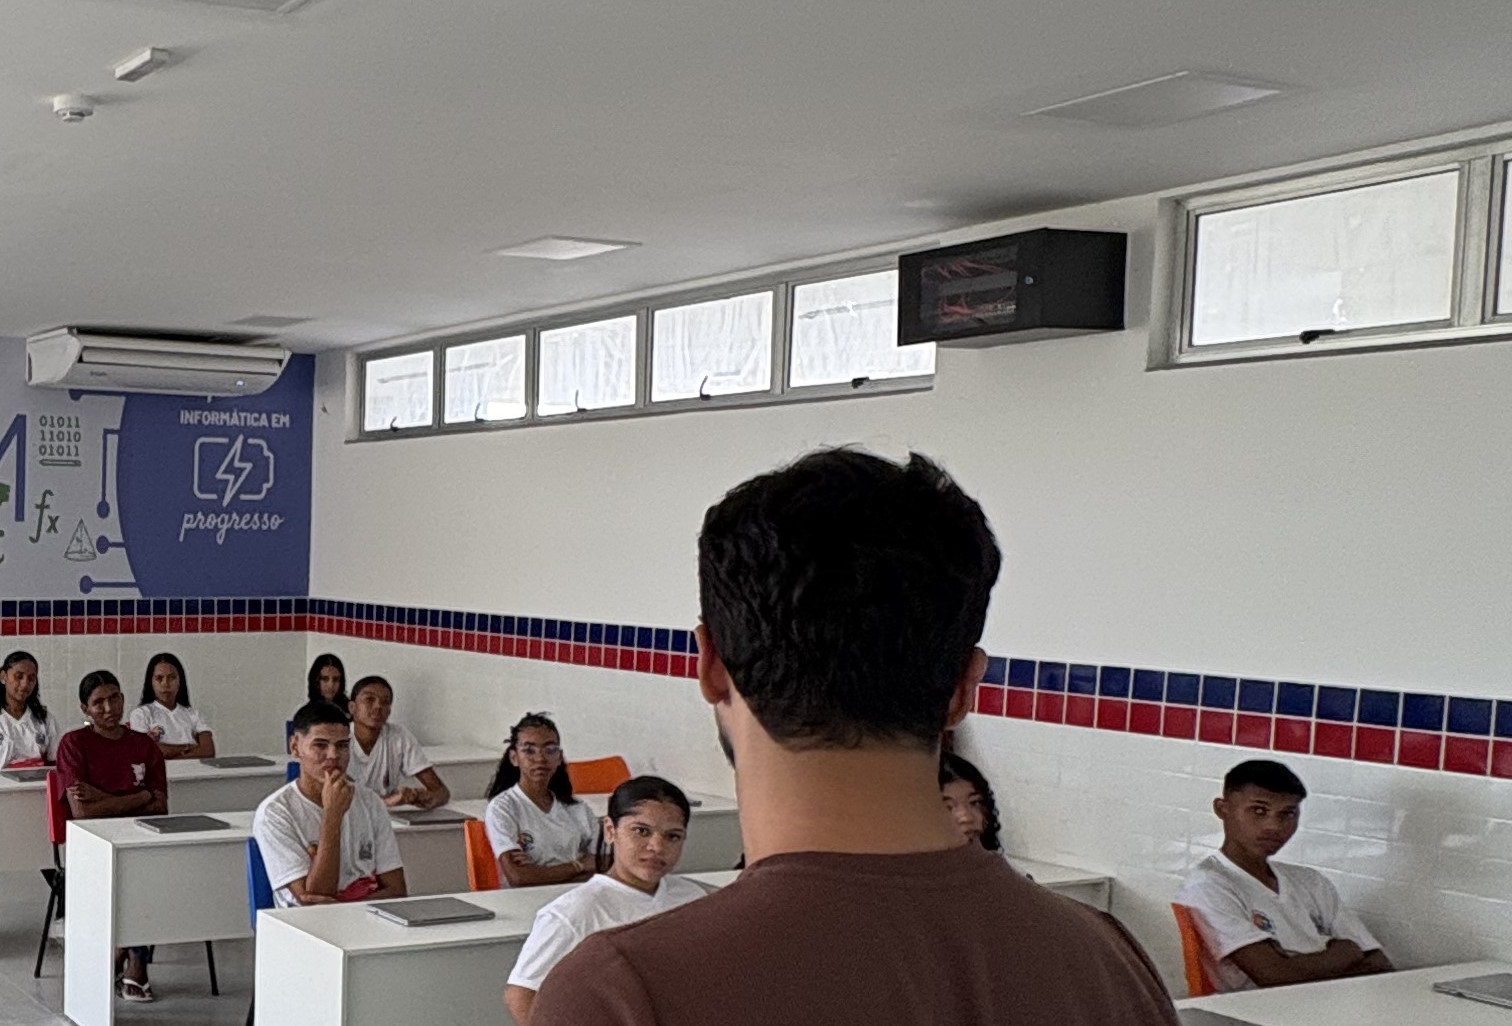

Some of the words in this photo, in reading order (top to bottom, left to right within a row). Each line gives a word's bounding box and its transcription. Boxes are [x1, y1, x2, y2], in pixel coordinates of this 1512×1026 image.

[39, 415, 80, 429] 01011
[179, 407, 269, 427] INFORMÁTICA
[271, 413, 290, 428] EM
[40, 429, 82, 443] 11010
[39, 444, 80, 457] 01011
[178, 511, 286, 545] progresso
